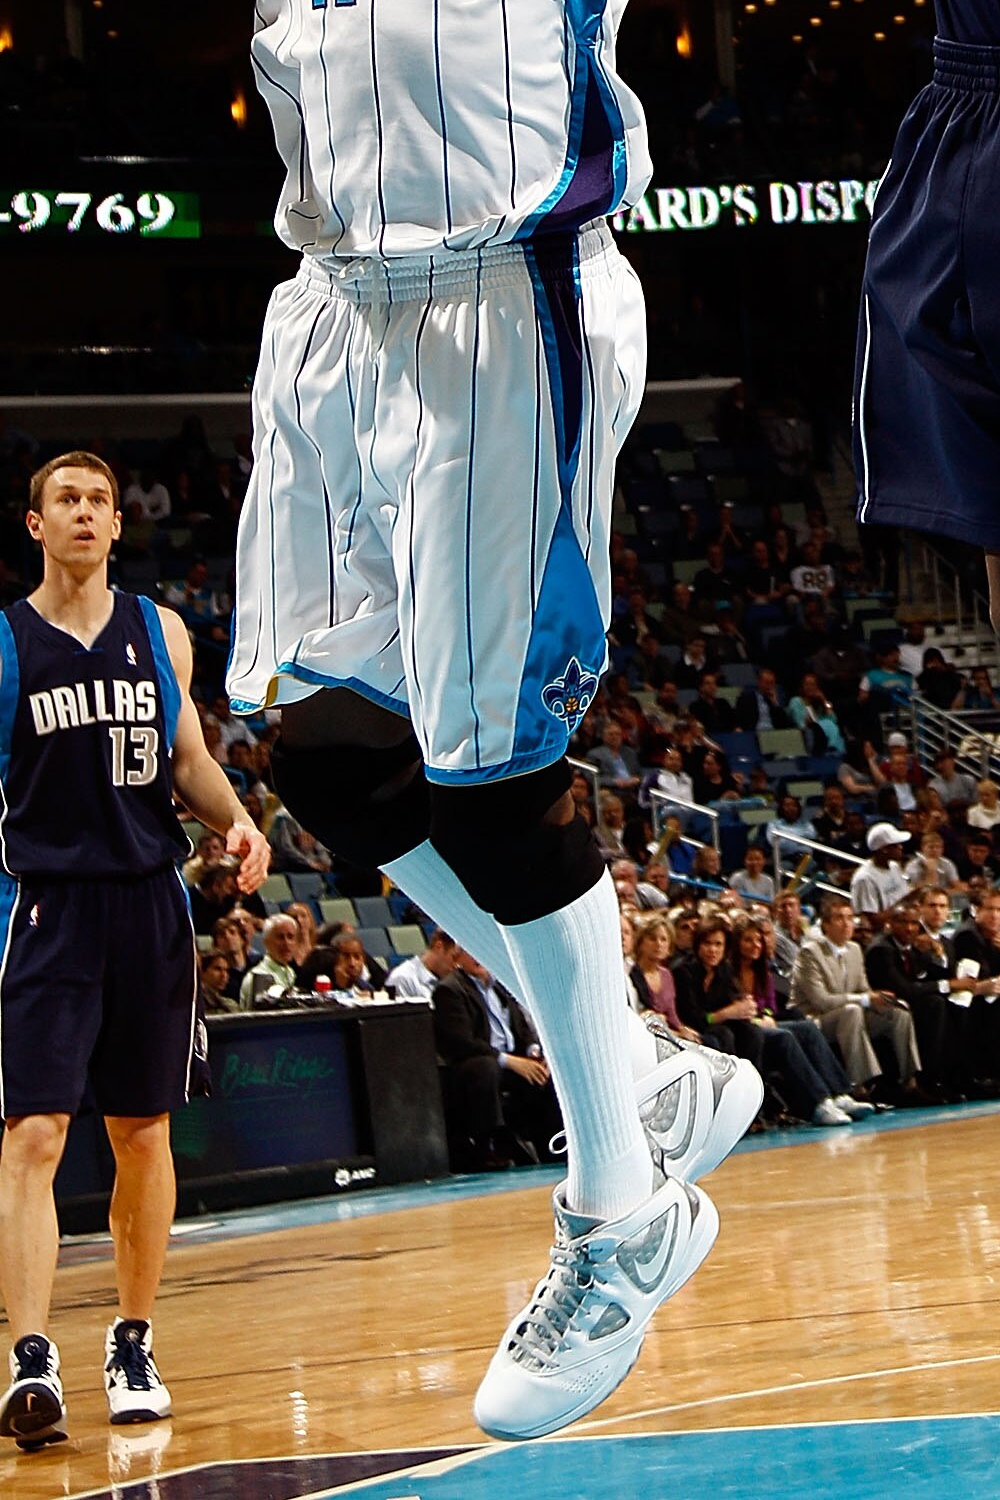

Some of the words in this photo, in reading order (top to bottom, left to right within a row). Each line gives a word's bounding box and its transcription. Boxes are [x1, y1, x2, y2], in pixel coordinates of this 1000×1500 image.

[613, 184, 758, 232] ARD'S
[28, 679, 157, 738] DALLAS
[109, 726, 159, 788] 13
